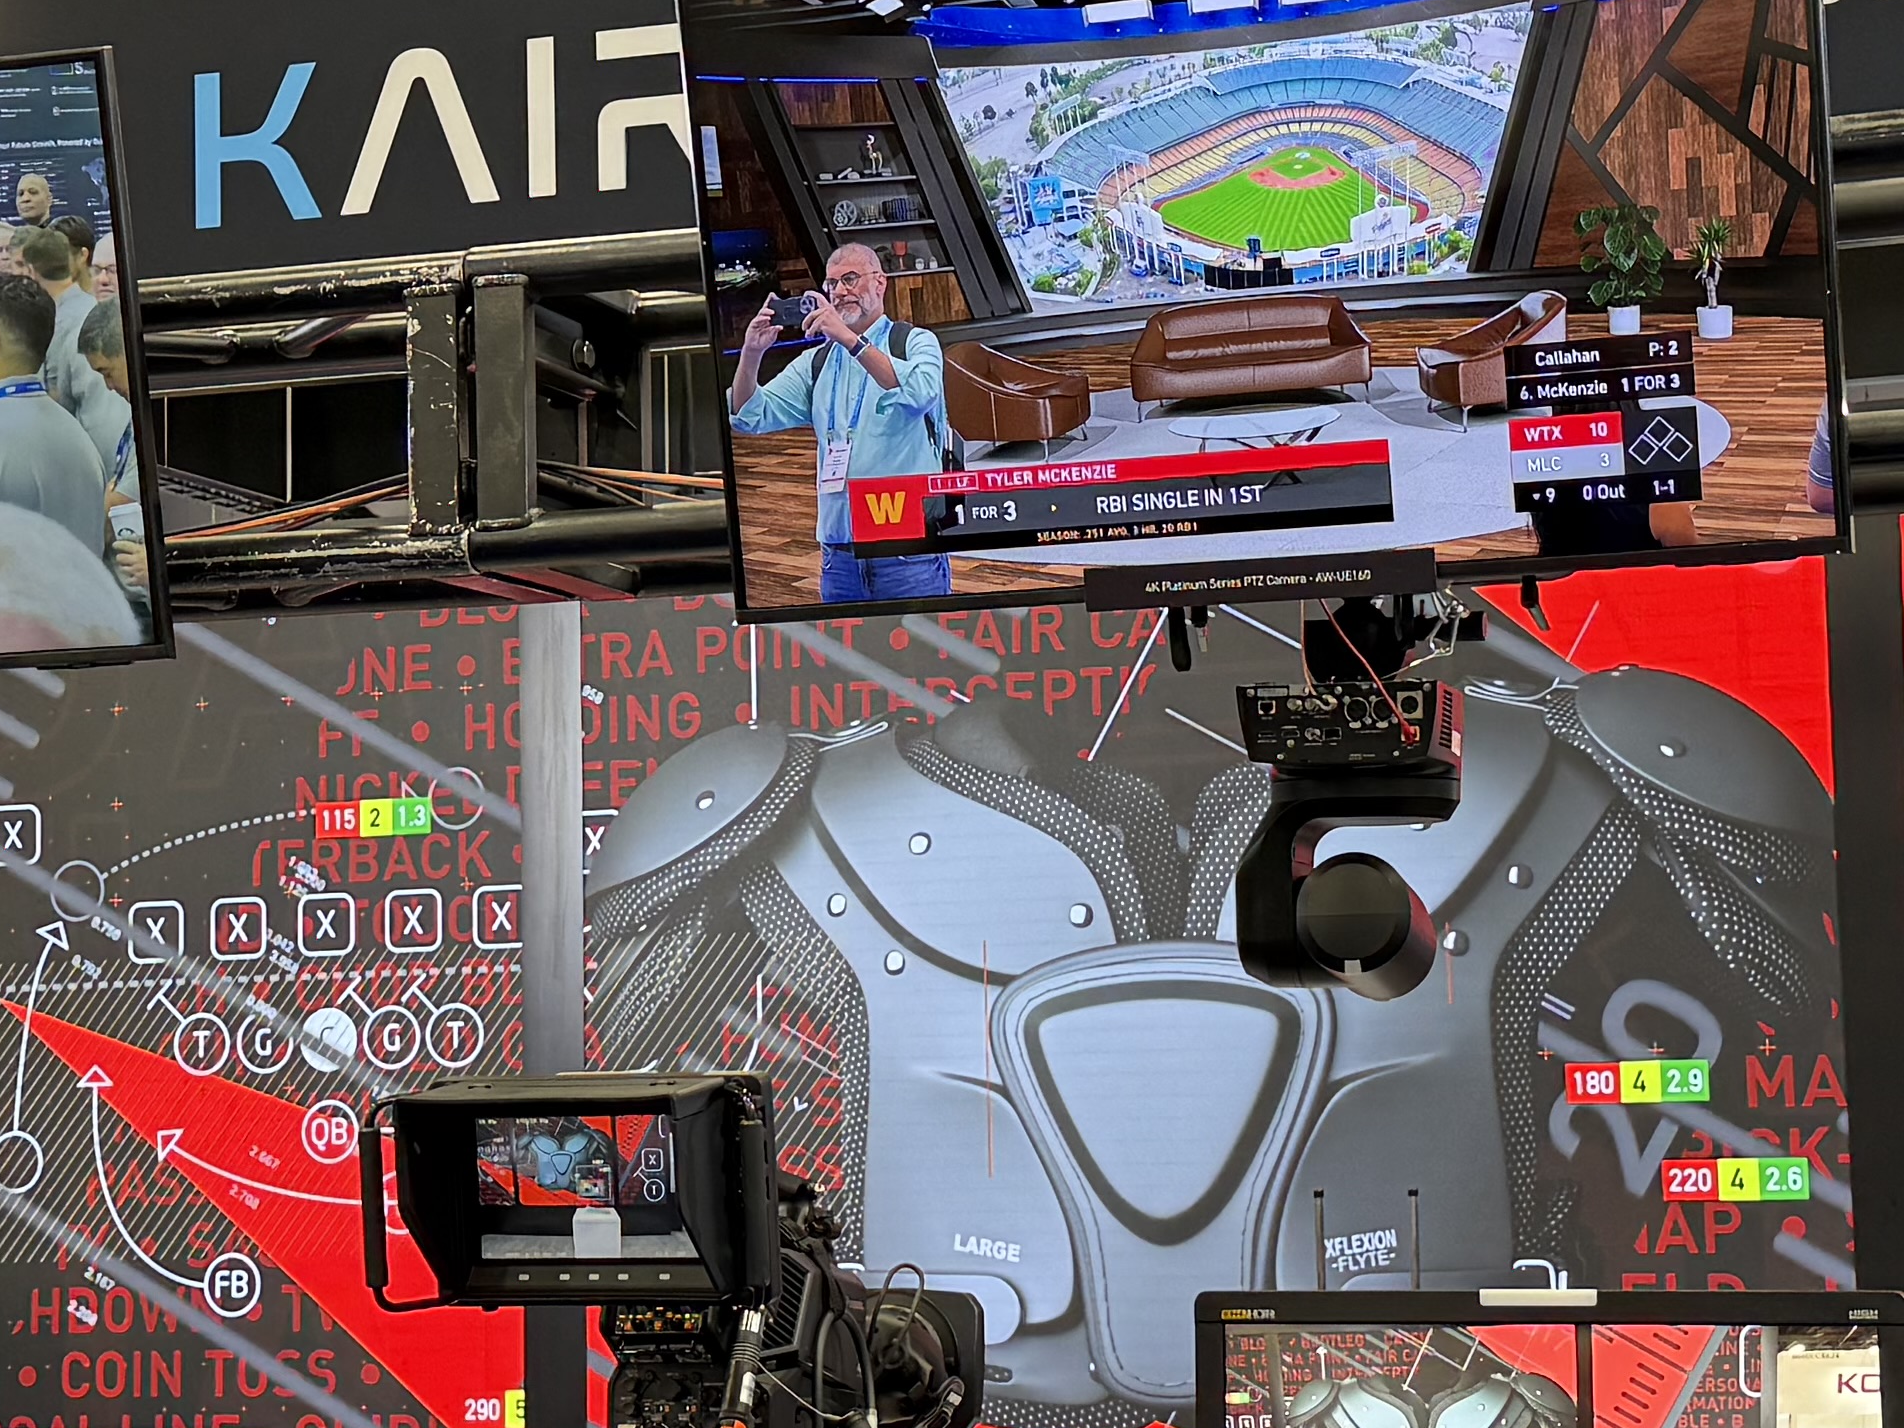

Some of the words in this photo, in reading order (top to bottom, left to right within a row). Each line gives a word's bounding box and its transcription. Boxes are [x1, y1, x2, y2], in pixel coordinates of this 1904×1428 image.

[1534, 348, 1601, 367] Callahan
[1648, 342, 1665, 357] P:
[1668, 340, 1679, 356] 2
[1520, 386, 1534, 401] 6.
[1537, 379, 1608, 399] McKenzie
[1621, 377, 1629, 393] 1
[1634, 375, 1666, 391] FOR
[1670, 373, 1681, 389] 3
[1524, 425, 1563, 443] WTX
[1589, 421, 1608, 438] 10
[984, 468, 1035, 488] TYLER
[1038, 463, 1117, 484] MCKENZIE
[1527, 456, 1562, 472] MLC
[1600, 452, 1610, 468] 3
[954, 504, 965, 525] 1
[971, 505, 998, 521] FOR
[1002, 501, 1018, 522] 3
[1096, 494, 1129, 514] RBI
[1132, 490, 1200, 512] SINGLE
[1204, 488, 1224, 508] IN
[1228, 484, 1264, 506] 1ST
[1545, 487, 1556, 503] 9
[1597, 483, 1626, 499] Out
[1653, 478, 1675, 496] 1-1
[864, 490, 906, 526] W
[322, 807, 356, 830] 115
[369, 807, 380, 828] 2
[398, 804, 426, 827] 1.3
[3, 820, 23, 850] X
[229, 913, 248, 942] X
[316, 910, 335, 938] X
[403, 906, 422, 935] X
[492, 901, 511, 931] X
[148, 918, 166, 944] X
[1573, 1069, 1615, 1095] 180
[1632, 1069, 1647, 1093] 4
[1665, 1067, 1705, 1093] 2.9
[311, 1117, 349, 1146] QB
[1667, 1167, 1713, 1193] 220
[1730, 1167, 1745, 1191] 4
[1765, 1166, 1804, 1191] 2.6
[954, 1233, 1022, 1264] LARGE
[1323, 1228, 1397, 1259] XFLEXION
[214, 1270, 249, 1299] FB
[61, 1350, 182, 1399] COIN
[205, 1349, 336, 1398] TOSS
[464, 1396, 501, 1422] 290
